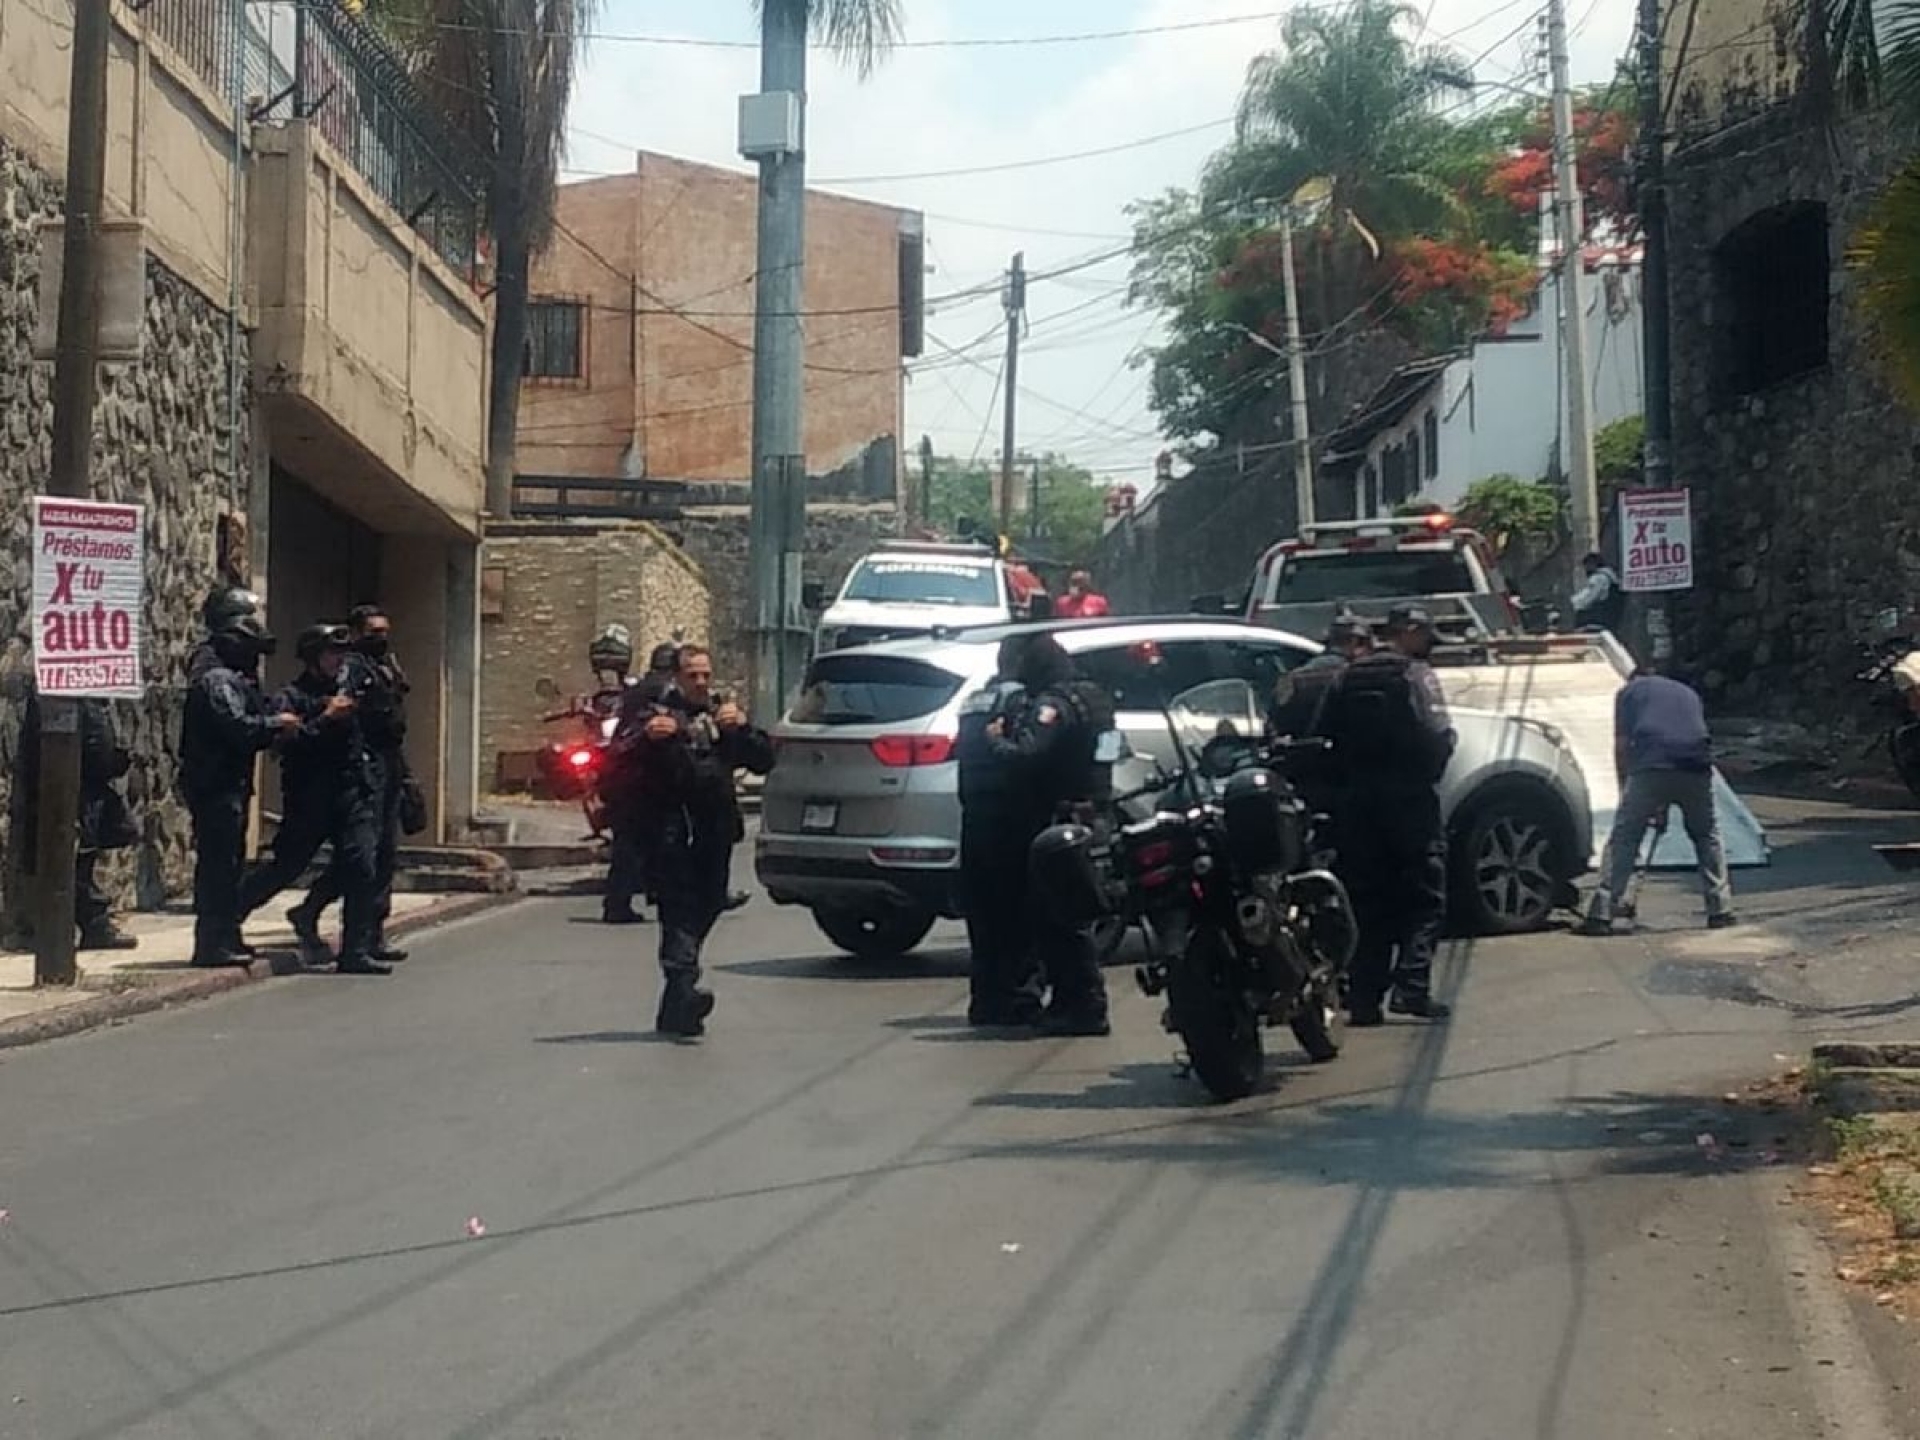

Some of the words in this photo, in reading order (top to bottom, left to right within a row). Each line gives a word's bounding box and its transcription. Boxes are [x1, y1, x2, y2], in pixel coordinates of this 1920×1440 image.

[43, 531, 133, 561] Préstamos
[1633, 521, 1648, 545] X
[1628, 537, 1685, 569] auto
[48, 561, 80, 605] X
[82, 564, 104, 591] tu
[42, 600, 130, 652] auto
